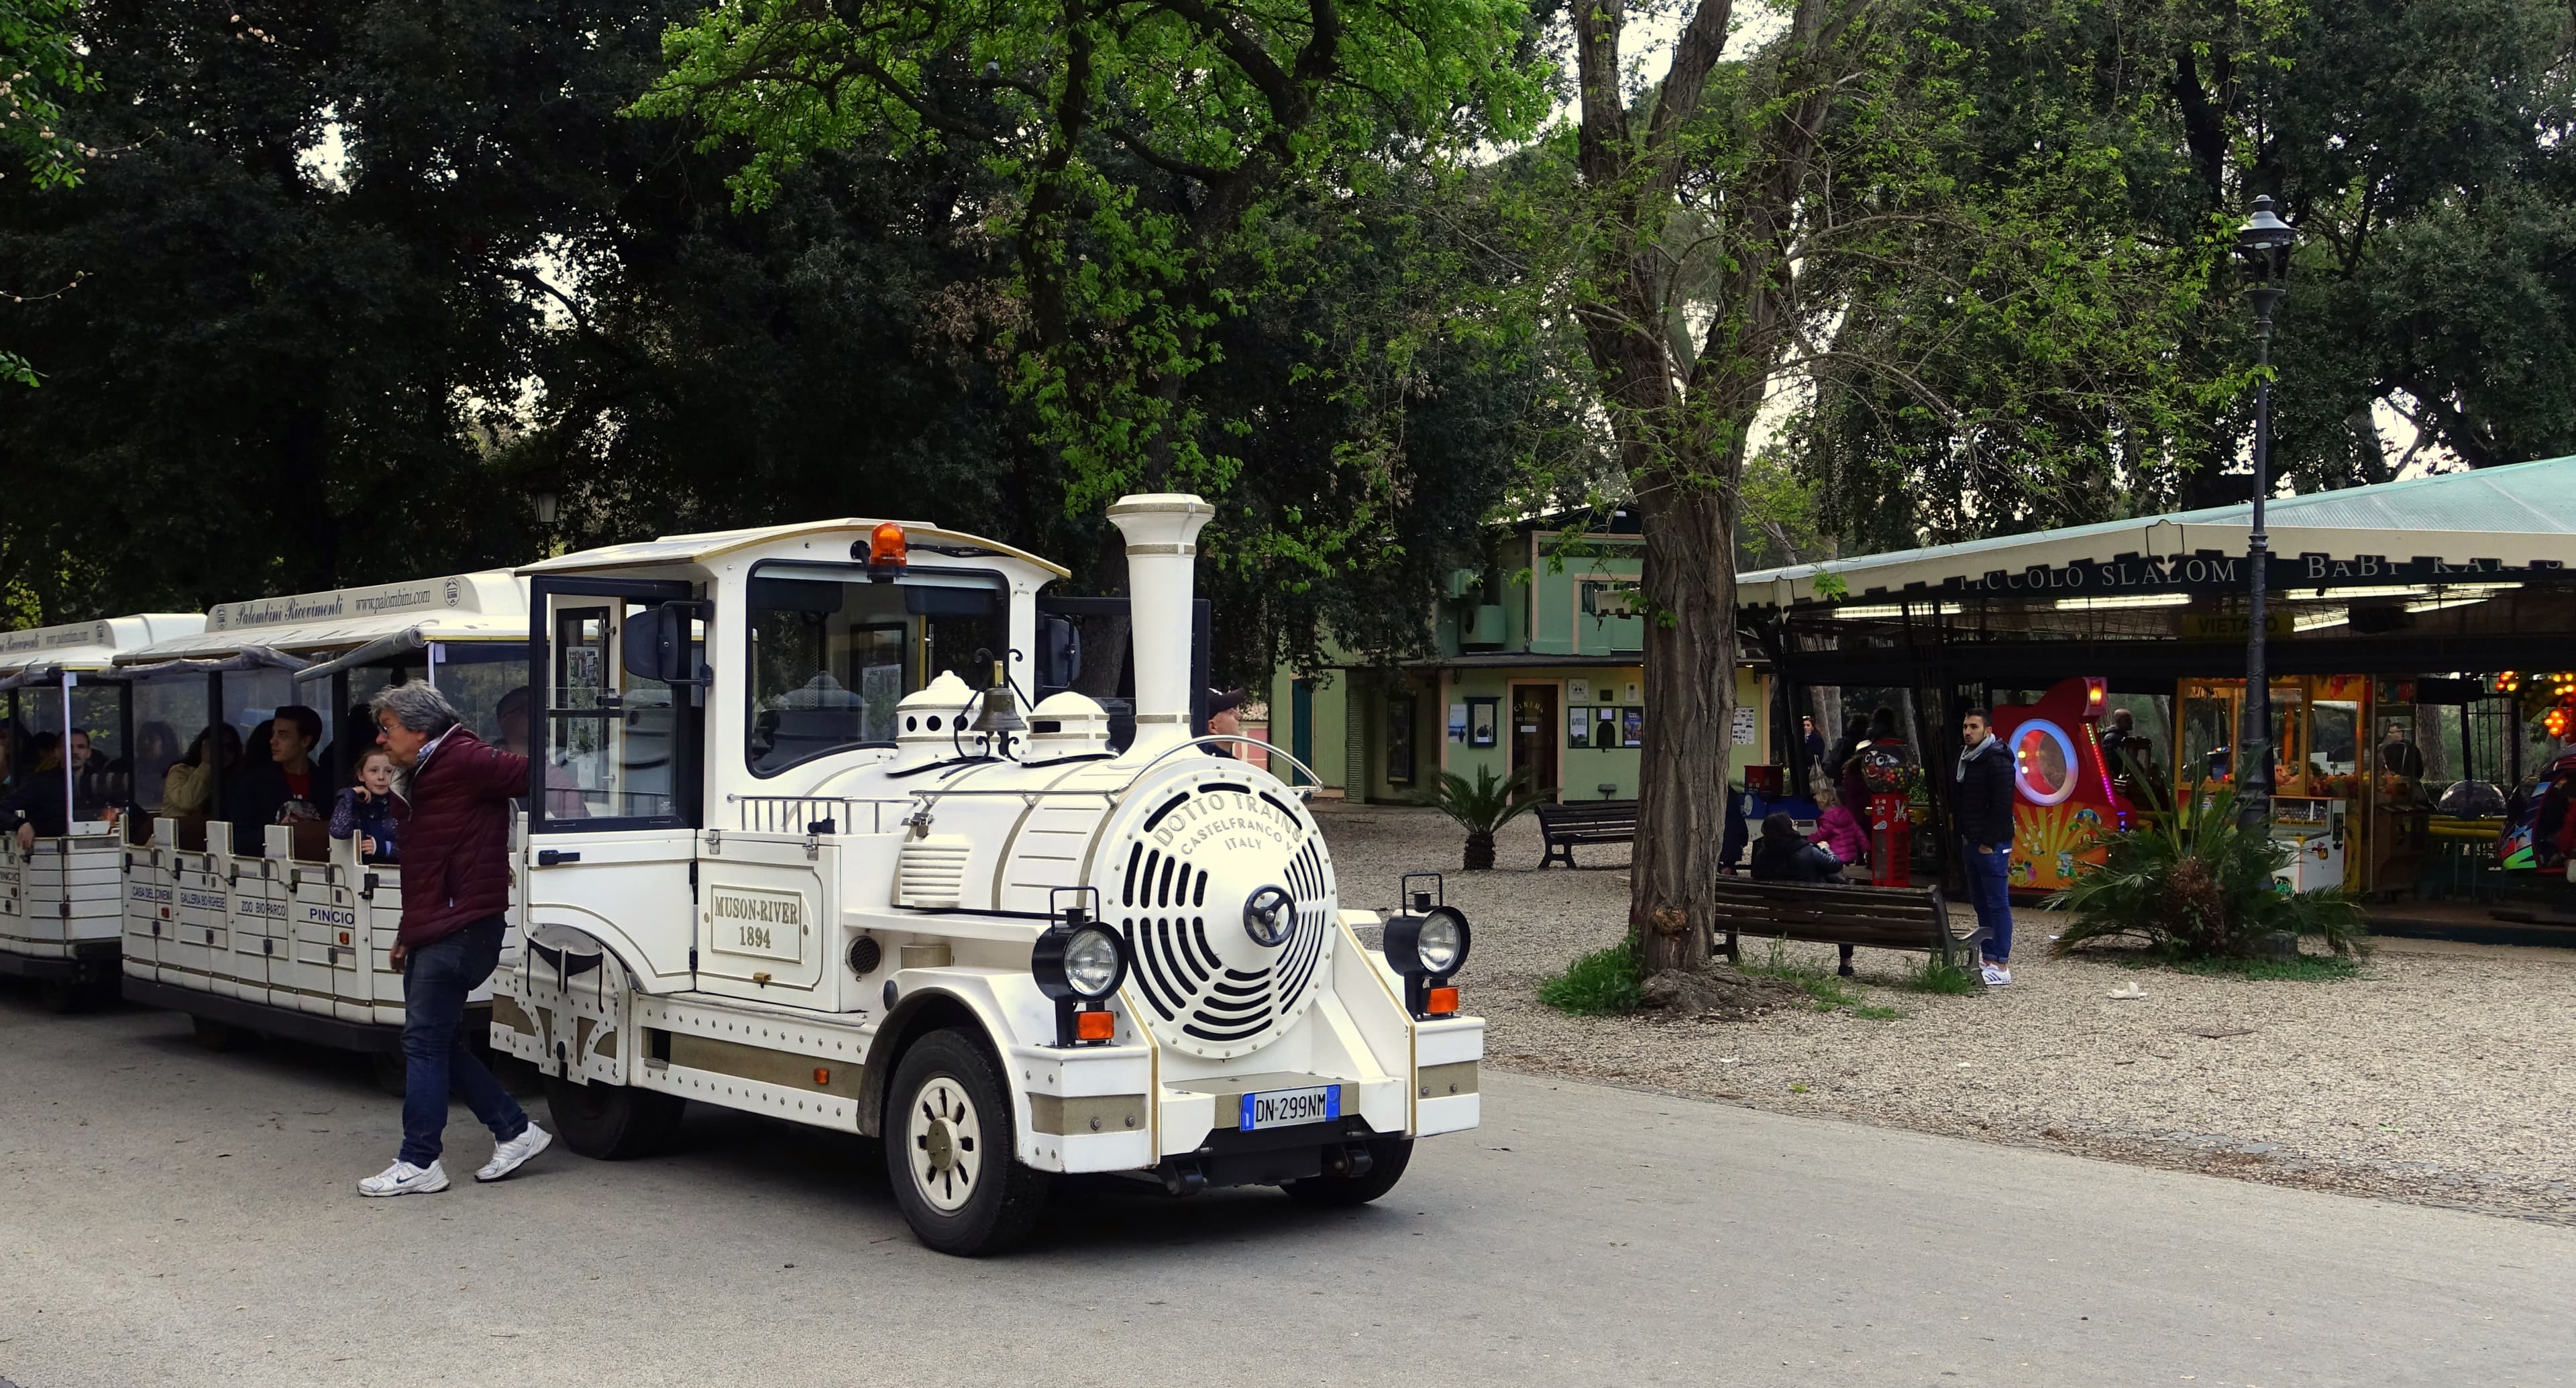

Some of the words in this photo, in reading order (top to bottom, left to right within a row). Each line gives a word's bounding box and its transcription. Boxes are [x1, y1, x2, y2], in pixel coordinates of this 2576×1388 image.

[235, 603, 282, 626] Palombini
[284, 594, 343, 619] Ricevimenti
[356, 588, 431, 614] www.palombini.com
[2198, 617, 2277, 633] VIETAO
[1153, 794, 1225, 847] DOTTO
[1233, 793, 1302, 843] TRAINS
[1181, 818, 1282, 855] CASTELFRANCO
[1224, 837, 1261, 850] ITALY
[241, 901, 253, 912] ZOO
[310, 908, 354, 925] PINCIO
[739, 926, 771, 949] 1894
